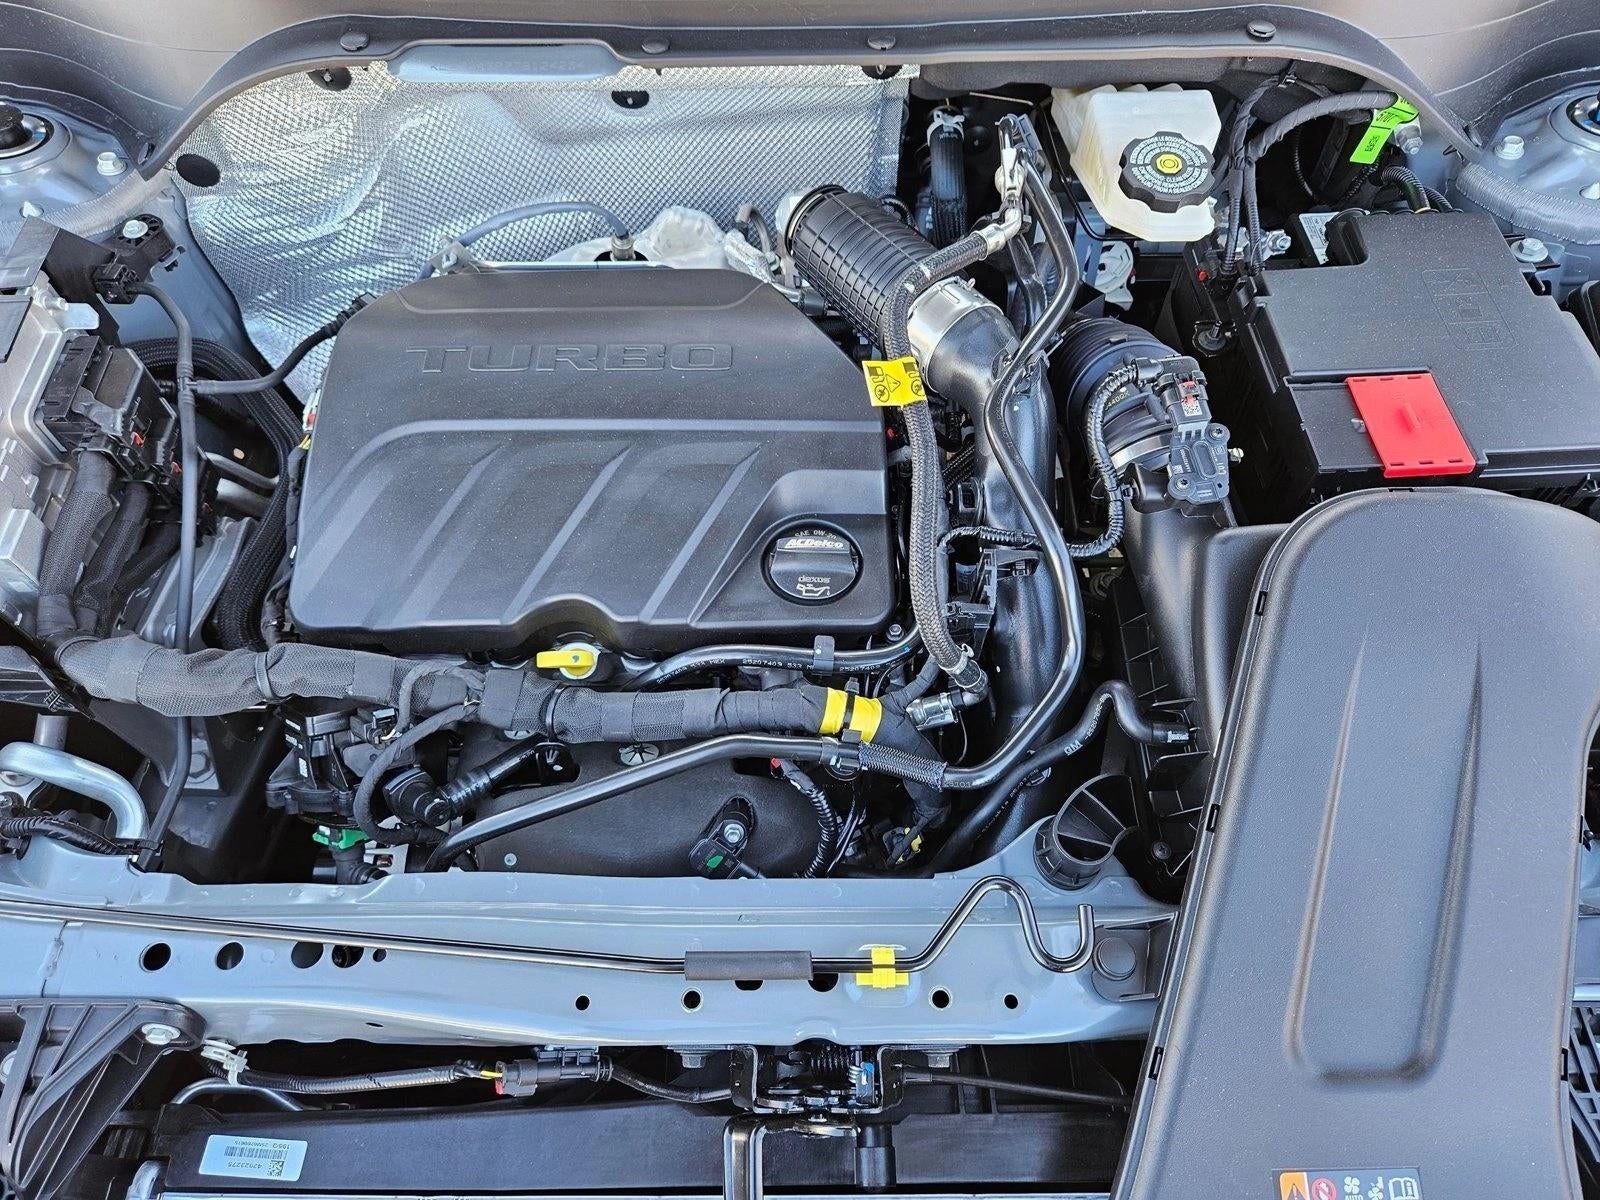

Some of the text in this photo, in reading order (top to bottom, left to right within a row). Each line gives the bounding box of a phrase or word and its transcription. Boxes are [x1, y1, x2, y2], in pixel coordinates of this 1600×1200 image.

[406, 344, 732, 373] TURBO
[798, 575, 831, 583] dexos
[742, 658, 783, 667] 25207409
[1064, 740, 1082, 756] GM
